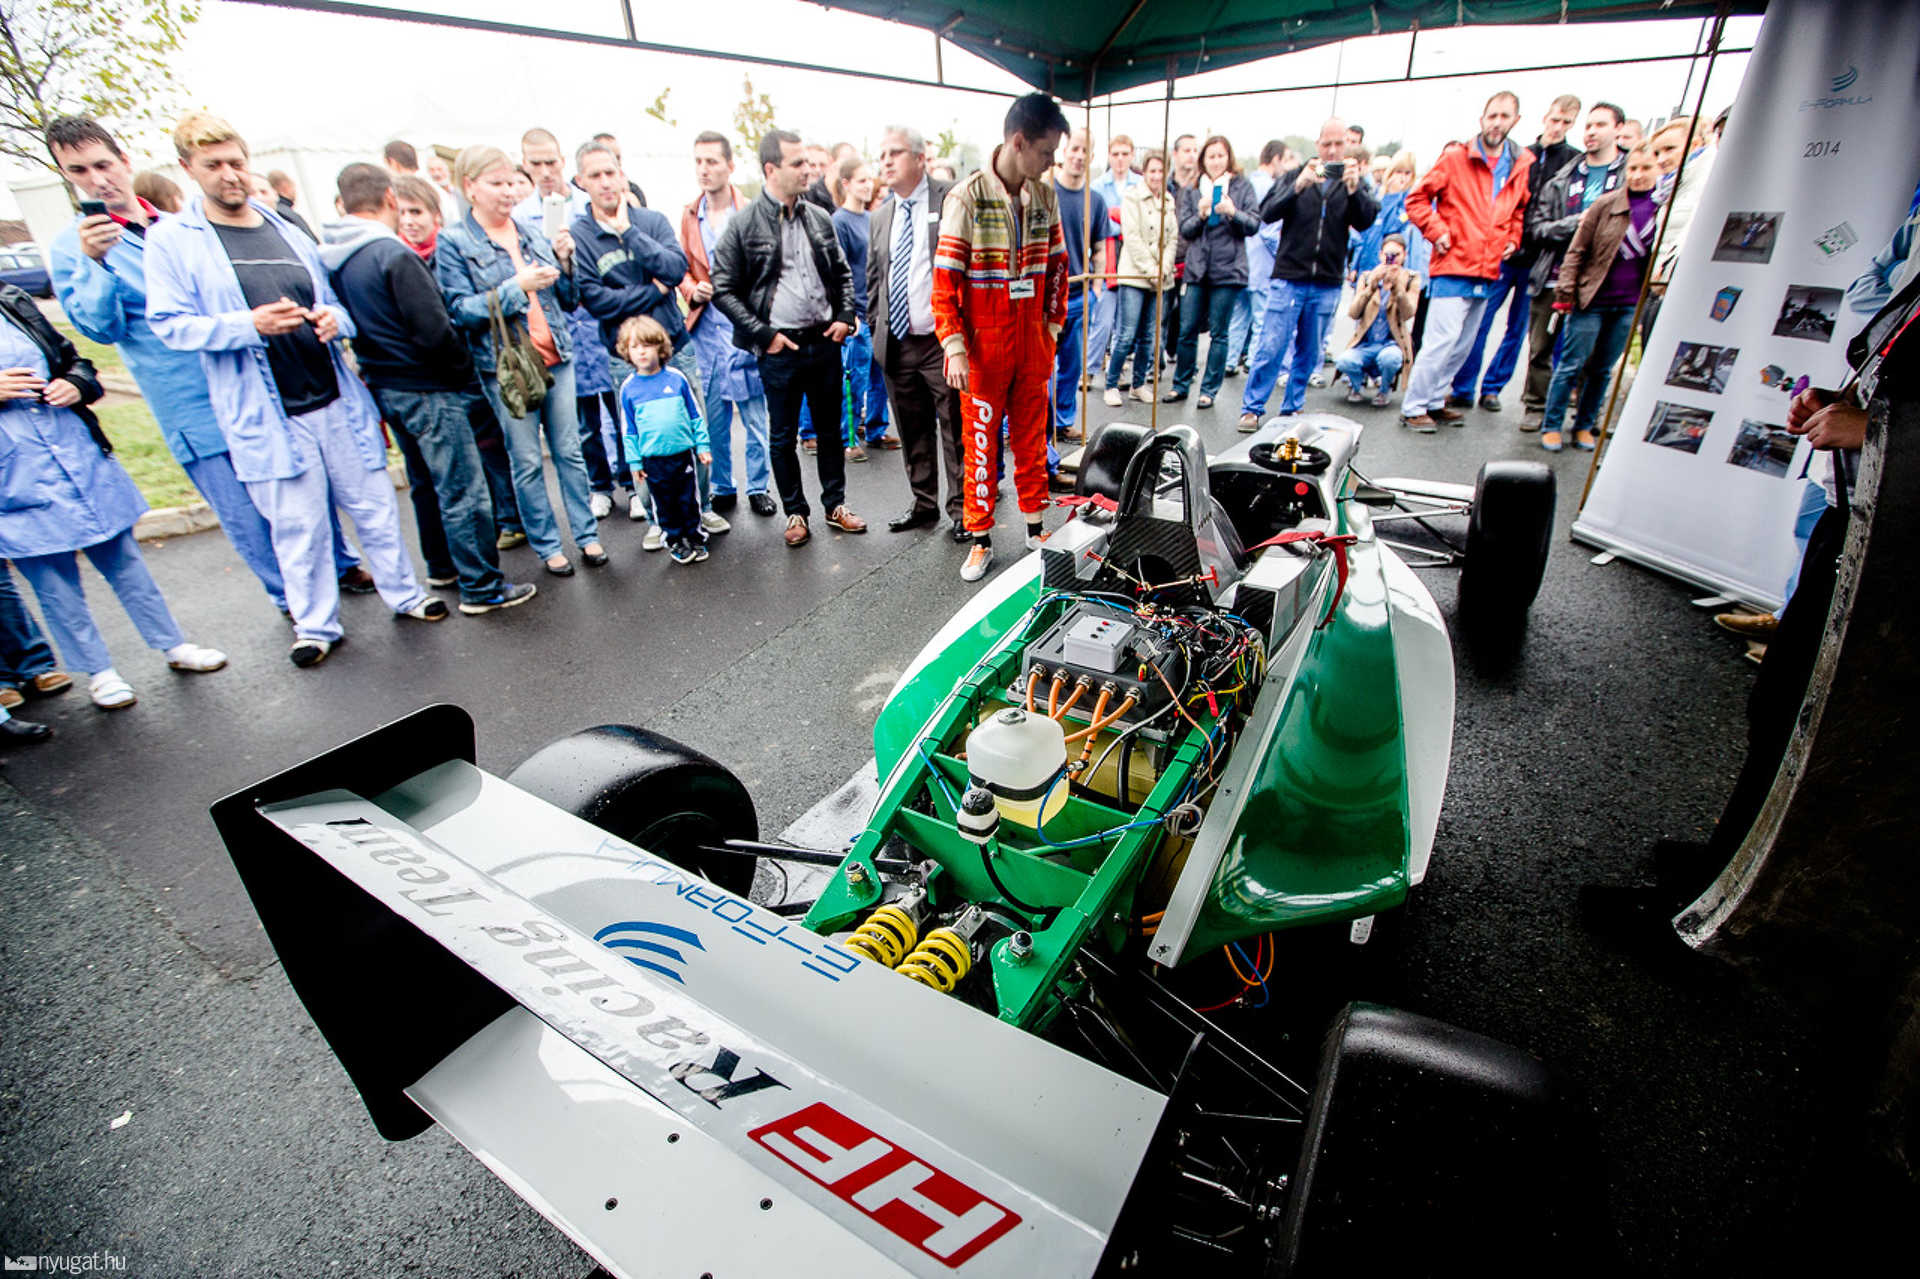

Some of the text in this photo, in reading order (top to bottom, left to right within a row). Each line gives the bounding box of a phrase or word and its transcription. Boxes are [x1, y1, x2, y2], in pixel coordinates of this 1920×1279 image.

[1803, 140, 1841, 158] 2014
[972, 397, 993, 512] Pioneer
[325, 816, 1007, 1259] HF Racing Team
